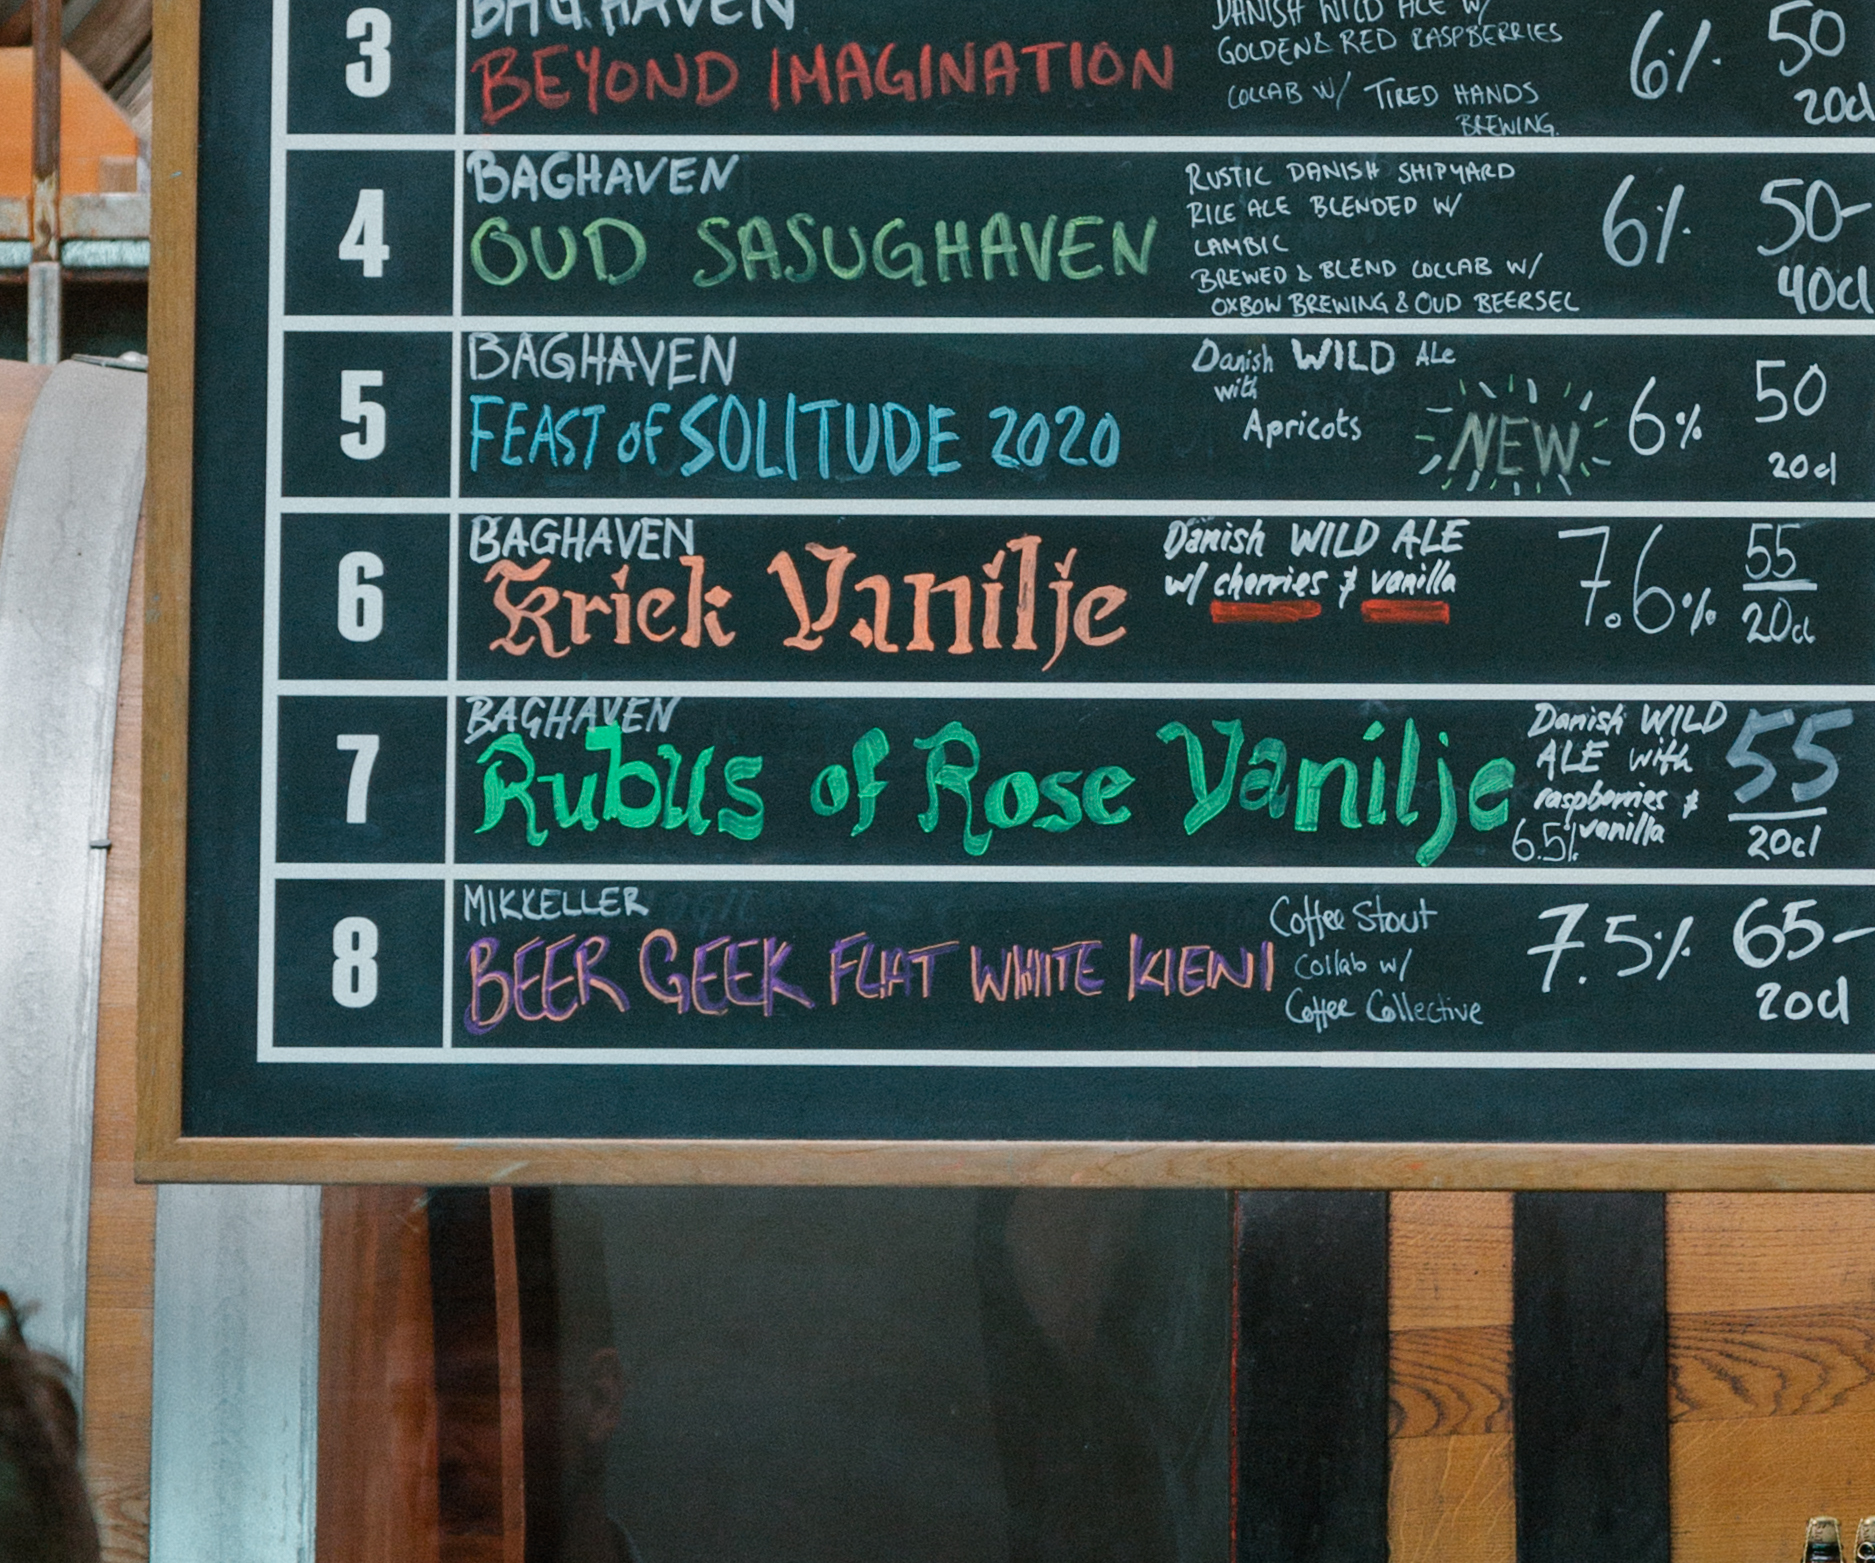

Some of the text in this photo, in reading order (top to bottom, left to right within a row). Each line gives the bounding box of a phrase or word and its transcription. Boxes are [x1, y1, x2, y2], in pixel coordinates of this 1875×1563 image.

[345, 7, 391, 98] 3
[471, 42, 1175, 126] BEYOND IMAGINATION
[1364, 77, 1540, 109] TIRED HANDS
[468, 148, 740, 203] BAGHAVEN
[1186, 161, 1516, 194] RUSTIC DANISH SHIPYARD
[339, 189, 390, 278] 4
[470, 211, 1159, 288] OUD SASUGHAVEN
[1196, 262, 1288, 293] BREWED
[1212, 291, 1388, 316] OXBOW BREWING
[467, 333, 737, 391] BAGHAVEN
[1193, 338, 1395, 375] Danish WILD
[339, 369, 387, 459] 5
[1755, 359, 1828, 424] 50
[470, 391, 1120, 480] FEAST SOLITUDE 2020
[1243, 409, 1362, 442] Apricots
[1448, 411, 1581, 478] NEW
[470, 516, 694, 563] BAGHAVEN
[1164, 518, 1471, 559] Danish WILD ALE
[338, 552, 385, 639] 6
[767, 534, 1129, 672] Vanilje
[1214, 567, 1456, 598] cherries vanilla
[464, 695, 681, 745] BAGHAVEN
[1528, 700, 1728, 738] Danish WILD
[335, 735, 381, 824] 7
[1538, 740, 1693, 775] ALE with
[1728, 708, 1853, 803] 55
[811, 726, 890, 837] of
[914, 720, 1136, 855] Rose
[1157, 720, 1512, 868] Vanilje
[462, 883, 649, 922] MIKKELLER
[1271, 896, 1438, 946] Coffee Stout
[332, 917, 379, 1008] 8
[464, 928, 1274, 1035] BEER GEEK FLAT WHITE KIENI
[1285, 988, 1484, 1032] Coffee Collective
